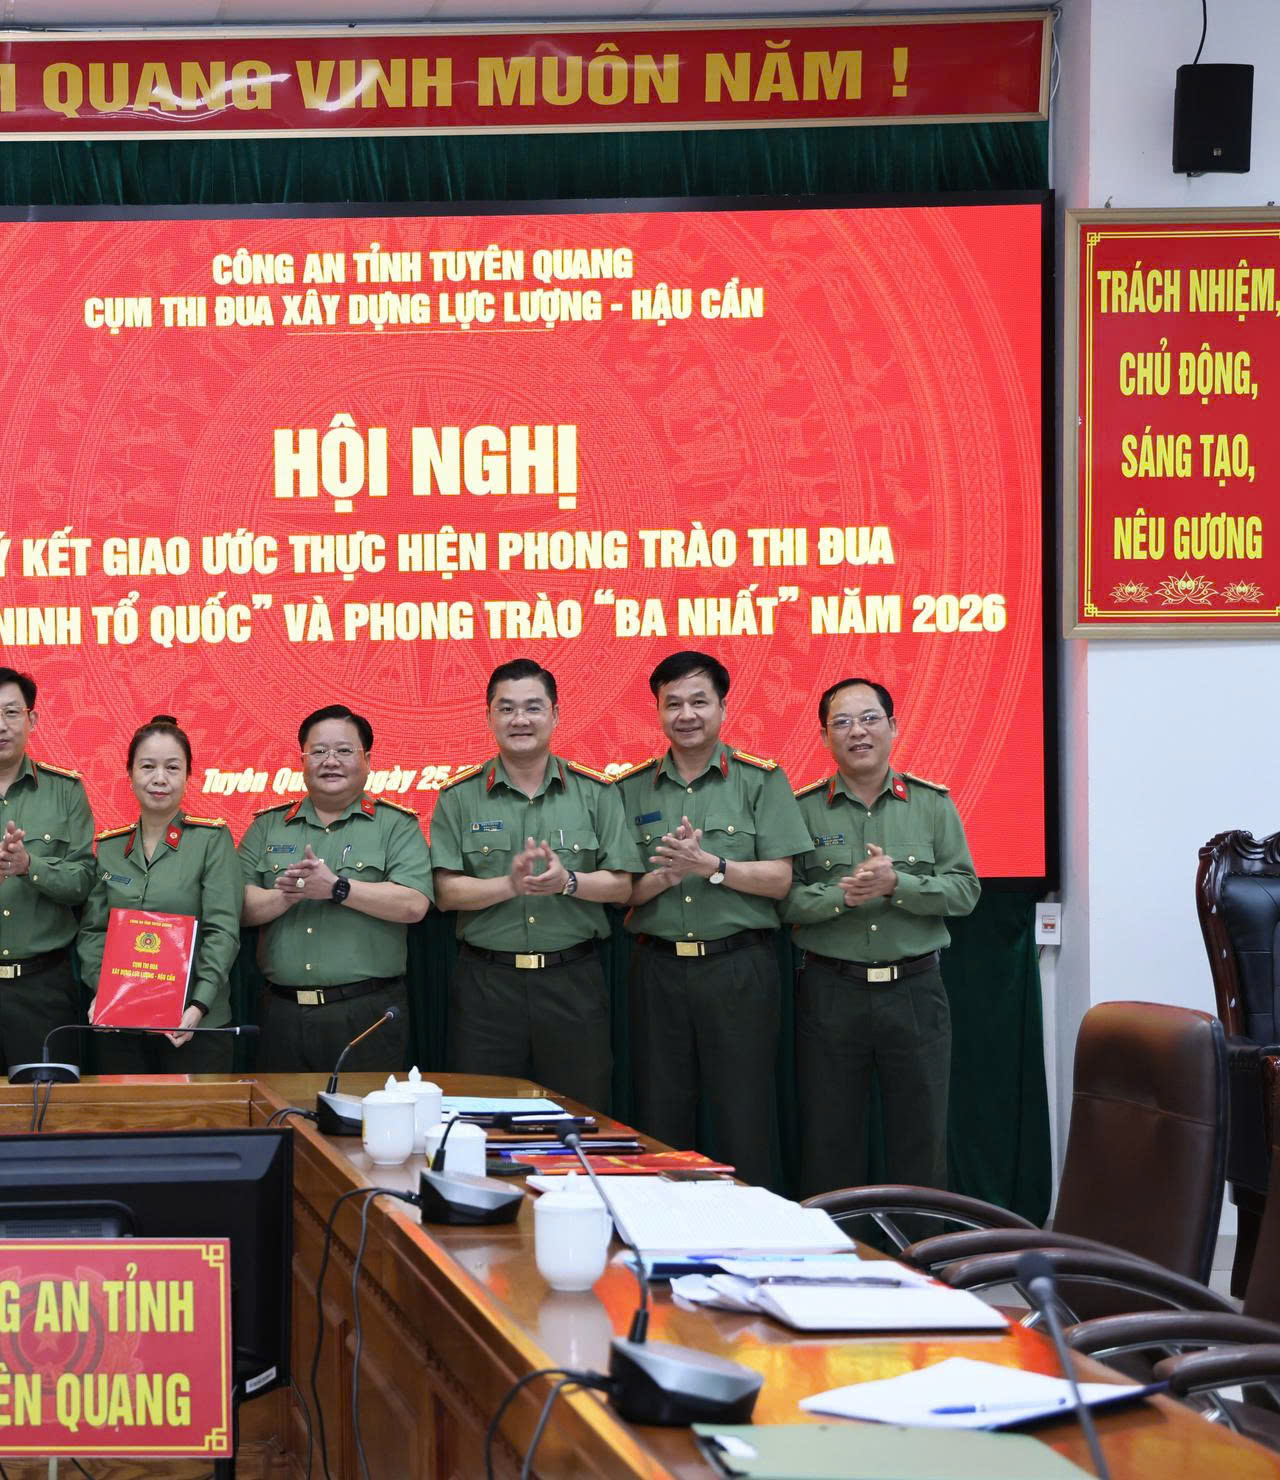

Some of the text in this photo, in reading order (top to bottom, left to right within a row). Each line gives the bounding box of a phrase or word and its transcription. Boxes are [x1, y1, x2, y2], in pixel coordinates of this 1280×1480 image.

[43, 61, 272, 118] QUANG
[296, 58, 452, 109] VINH
[477, 43, 679, 107] MUÔN
[705, 40, 862, 102] NĂM
[892, 47, 908, 97] !
[213, 242, 633, 285] CÔNG AN TỈNH TUYÊN QUANG
[1097, 260, 1280, 321] TRÁCH NHIỆM,
[85, 297, 152, 334] CỤM
[160, 297, 206, 327] THI
[215, 296, 274, 326] ĐUA
[282, 289, 340, 325] XÂY
[349, 291, 430, 331] DỰNG
[439, 290, 495, 329] LỰC
[504, 288, 602, 328] LƯỢNG
[632, 283, 692, 326] HẬU
[1120, 337, 1257, 404] CHỦ ĐỘNG,
[274, 413, 577, 512] HỘI NGHỊ
[1122, 426, 1254, 486] SÁNG TẠO,
[23, 526, 91, 576] KẾT
[103, 536, 190, 576] GIAO
[203, 528, 278, 575] ƯỚC
[289, 531, 385, 581] THỰC
[398, 526, 486, 579] HIỆN
[499, 530, 628, 570] PHONG
[639, 522, 736, 568] TRÀO
[748, 528, 807, 566] THI
[818, 526, 895, 565] ĐUA
[1114, 508, 1262, 560] NÊU GƯƠNG
[92, 591, 139, 644] TỔ
[284, 596, 334, 642] VÀ
[345, 602, 473, 640] PHONG
[484, 592, 582, 639] TRÀO
[812, 588, 901, 634] NĂM
[913, 594, 1006, 632] 2026
[203, 768, 268, 795] Tuyên
[34, 1280, 89, 1333] AN
[102, 1263, 193, 1332] TỈNH
[57, 1373, 190, 1432] QUANG
